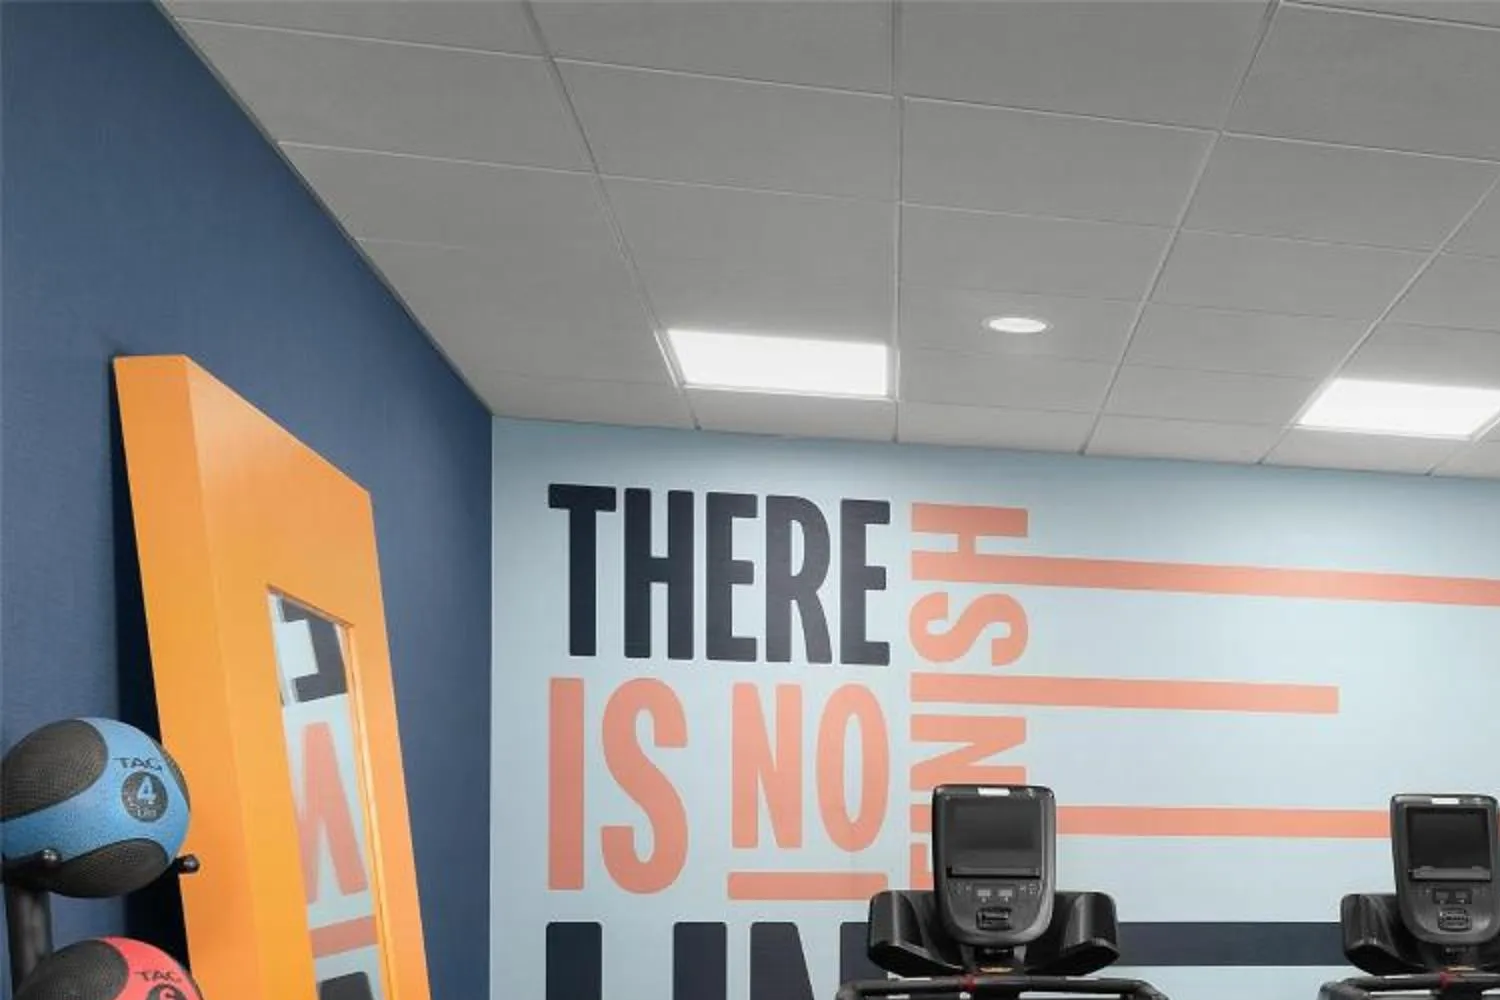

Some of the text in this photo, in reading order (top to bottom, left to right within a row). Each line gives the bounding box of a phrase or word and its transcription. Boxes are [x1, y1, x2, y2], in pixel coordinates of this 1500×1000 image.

[548, 483, 891, 666] THERE
[112, 756, 163, 771] TAG
[548, 677, 689, 895] IS
[730, 682, 890, 853] NO
[909, 502, 1029, 890] INISH
[136, 775, 157, 806] 4
